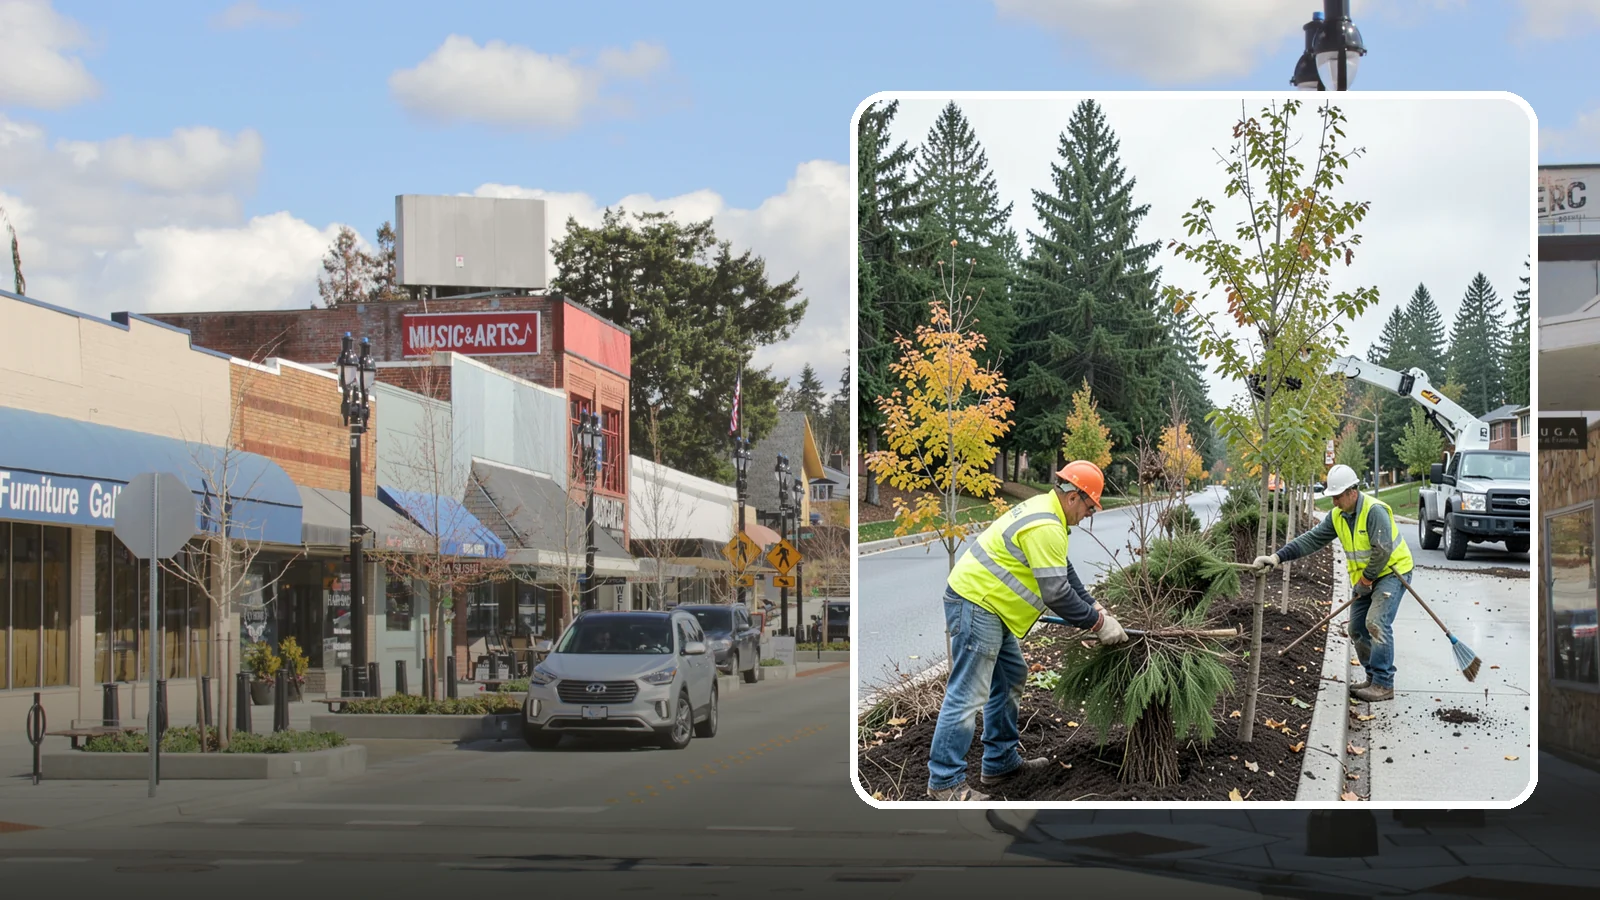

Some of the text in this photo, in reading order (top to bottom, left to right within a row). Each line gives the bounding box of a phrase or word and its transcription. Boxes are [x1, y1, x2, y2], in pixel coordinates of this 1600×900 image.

[0, 471, 121, 519] Furniture Gal
[453, 563, 479, 574] SUSHI
